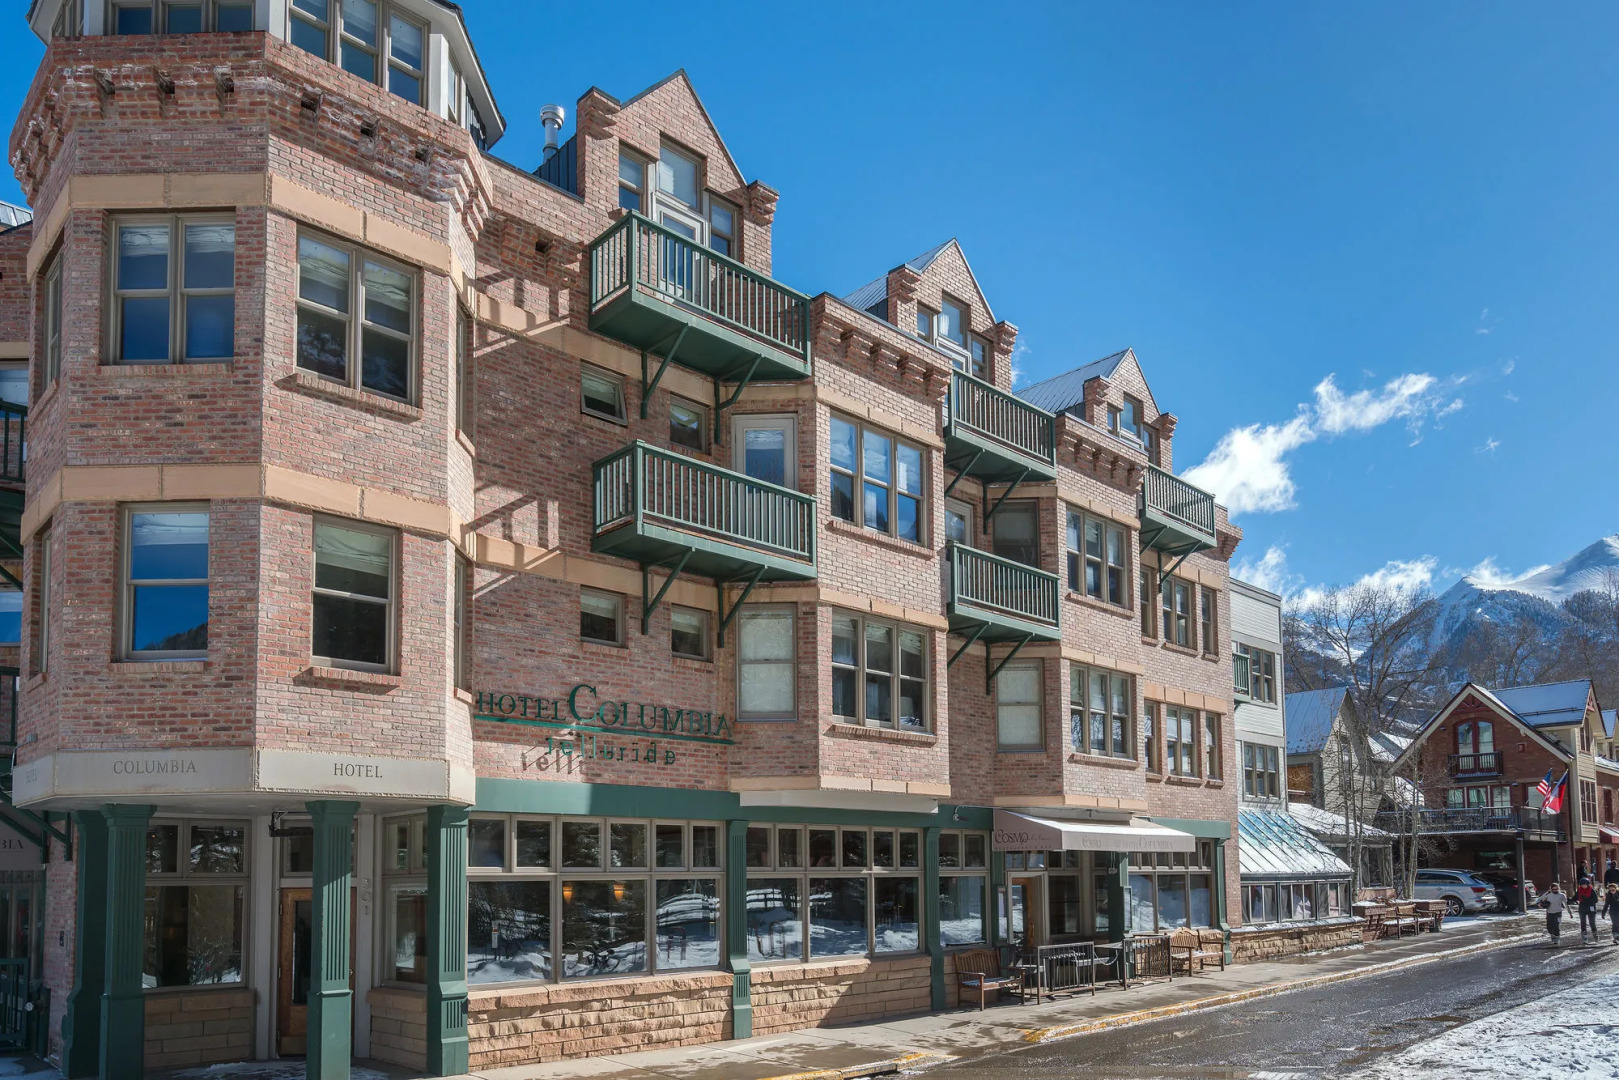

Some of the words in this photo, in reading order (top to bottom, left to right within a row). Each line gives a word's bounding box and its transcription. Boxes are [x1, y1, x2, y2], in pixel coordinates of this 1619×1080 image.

[477, 691, 567, 721] HOTEL
[568, 684, 733, 738] COLUMBIA
[546, 734, 677, 766] telluride
[113, 759, 198, 775] COLUMBIA
[333, 762, 383, 778] HOTEL
